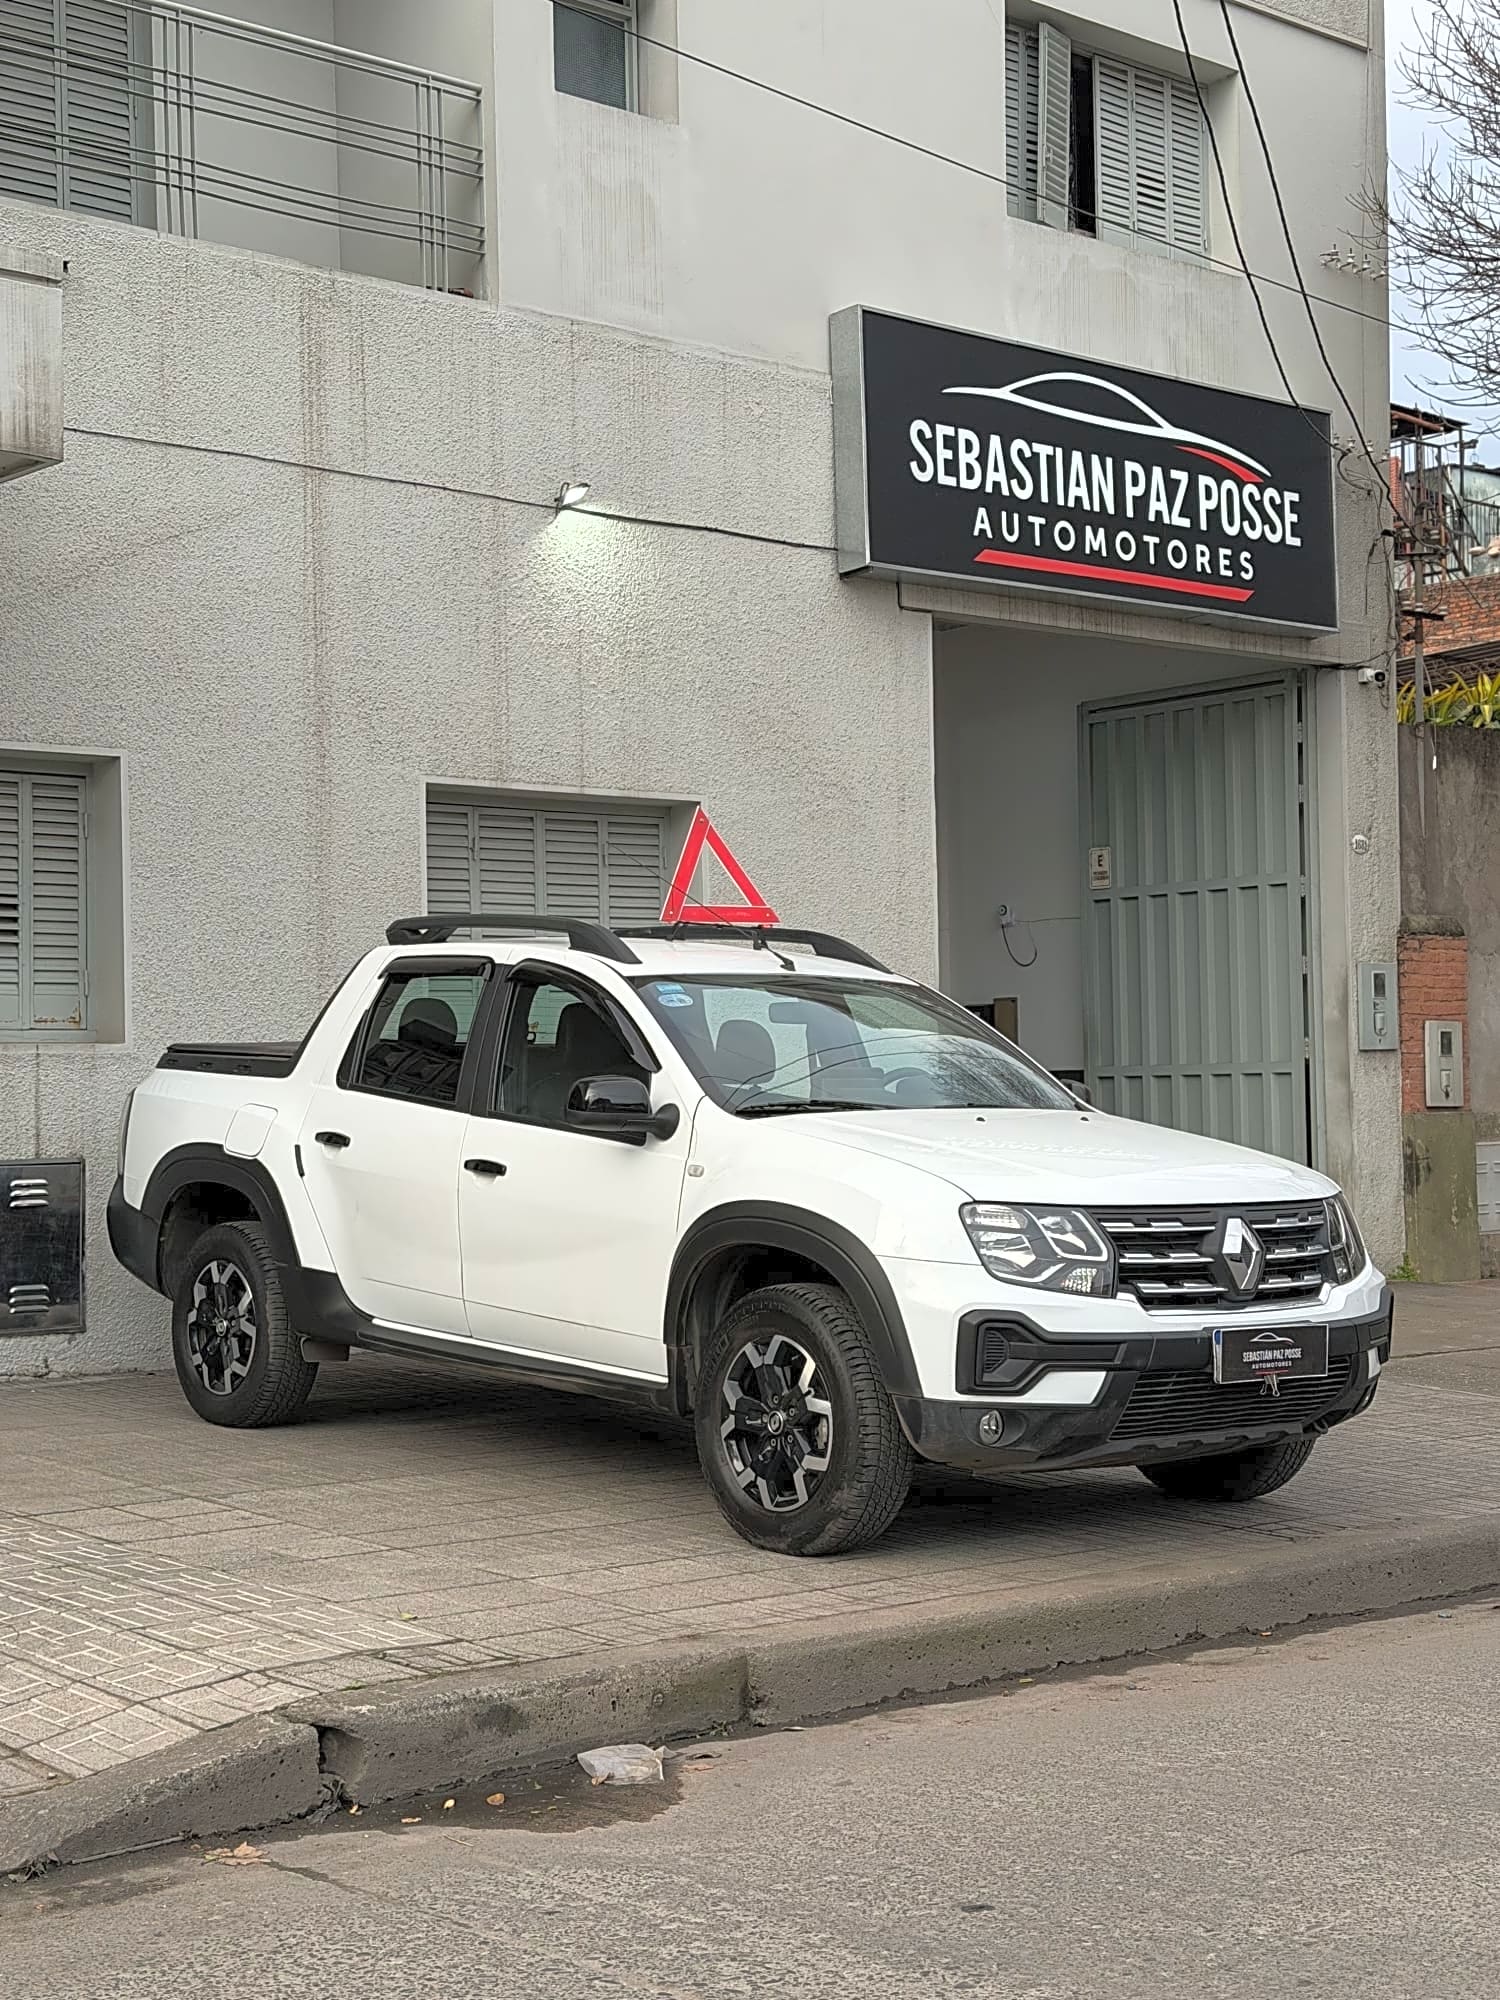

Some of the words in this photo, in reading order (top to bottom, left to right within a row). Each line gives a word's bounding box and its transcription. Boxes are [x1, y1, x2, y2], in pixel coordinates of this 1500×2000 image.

[909, 419, 1115, 515] SEBASTIAN
[1124, 460, 1192, 528] PAZ
[1200, 474, 1302, 547] POSSE
[973, 507, 1255, 581] AUTOMOTORES
[1097, 854, 1104, 867] E
[1273, 1349, 1284, 1359] PAZ
[1284, 1348, 1302, 1358] POSSE
[1252, 1360, 1292, 1369] AUTOMOTORES
